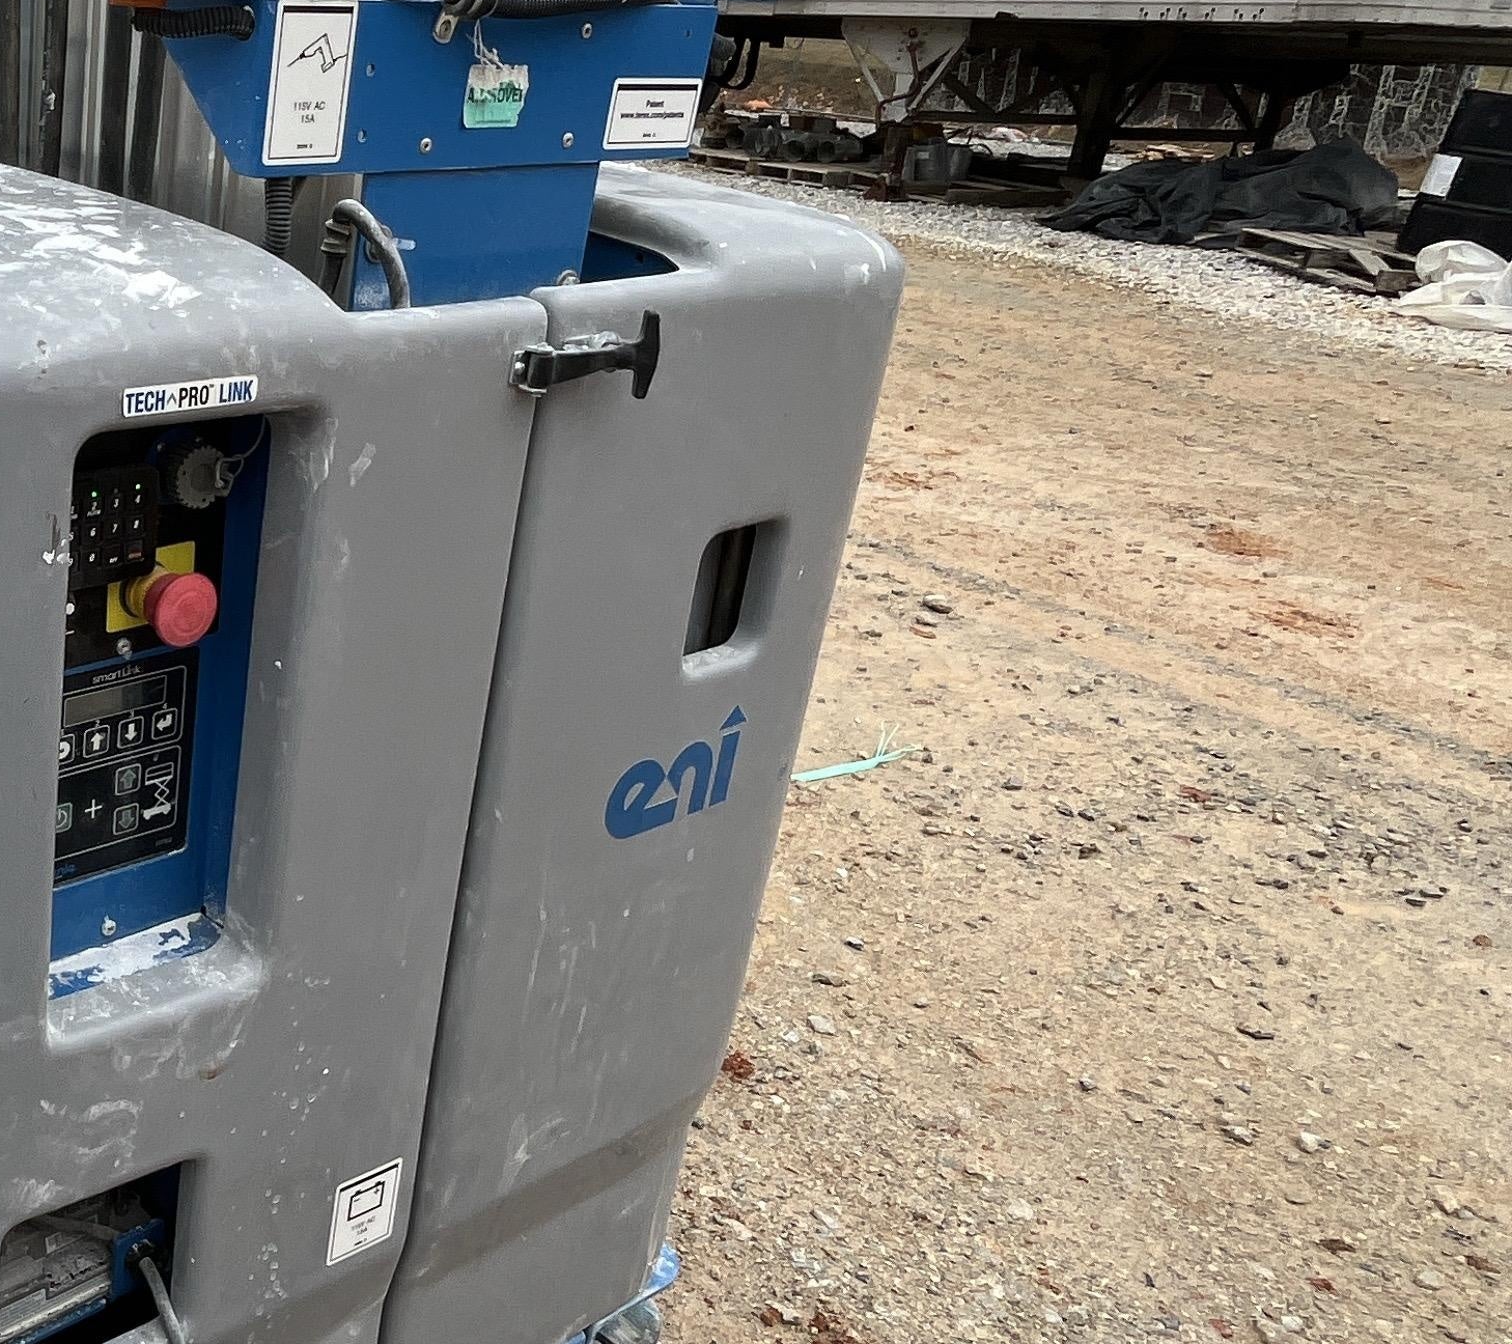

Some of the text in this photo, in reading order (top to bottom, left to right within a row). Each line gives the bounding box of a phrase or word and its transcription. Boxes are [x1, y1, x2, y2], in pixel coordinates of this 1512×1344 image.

[293, 100, 326, 112] 115V AC
[301, 113, 315, 124] 15A
[219, 379, 254, 404] LINK
